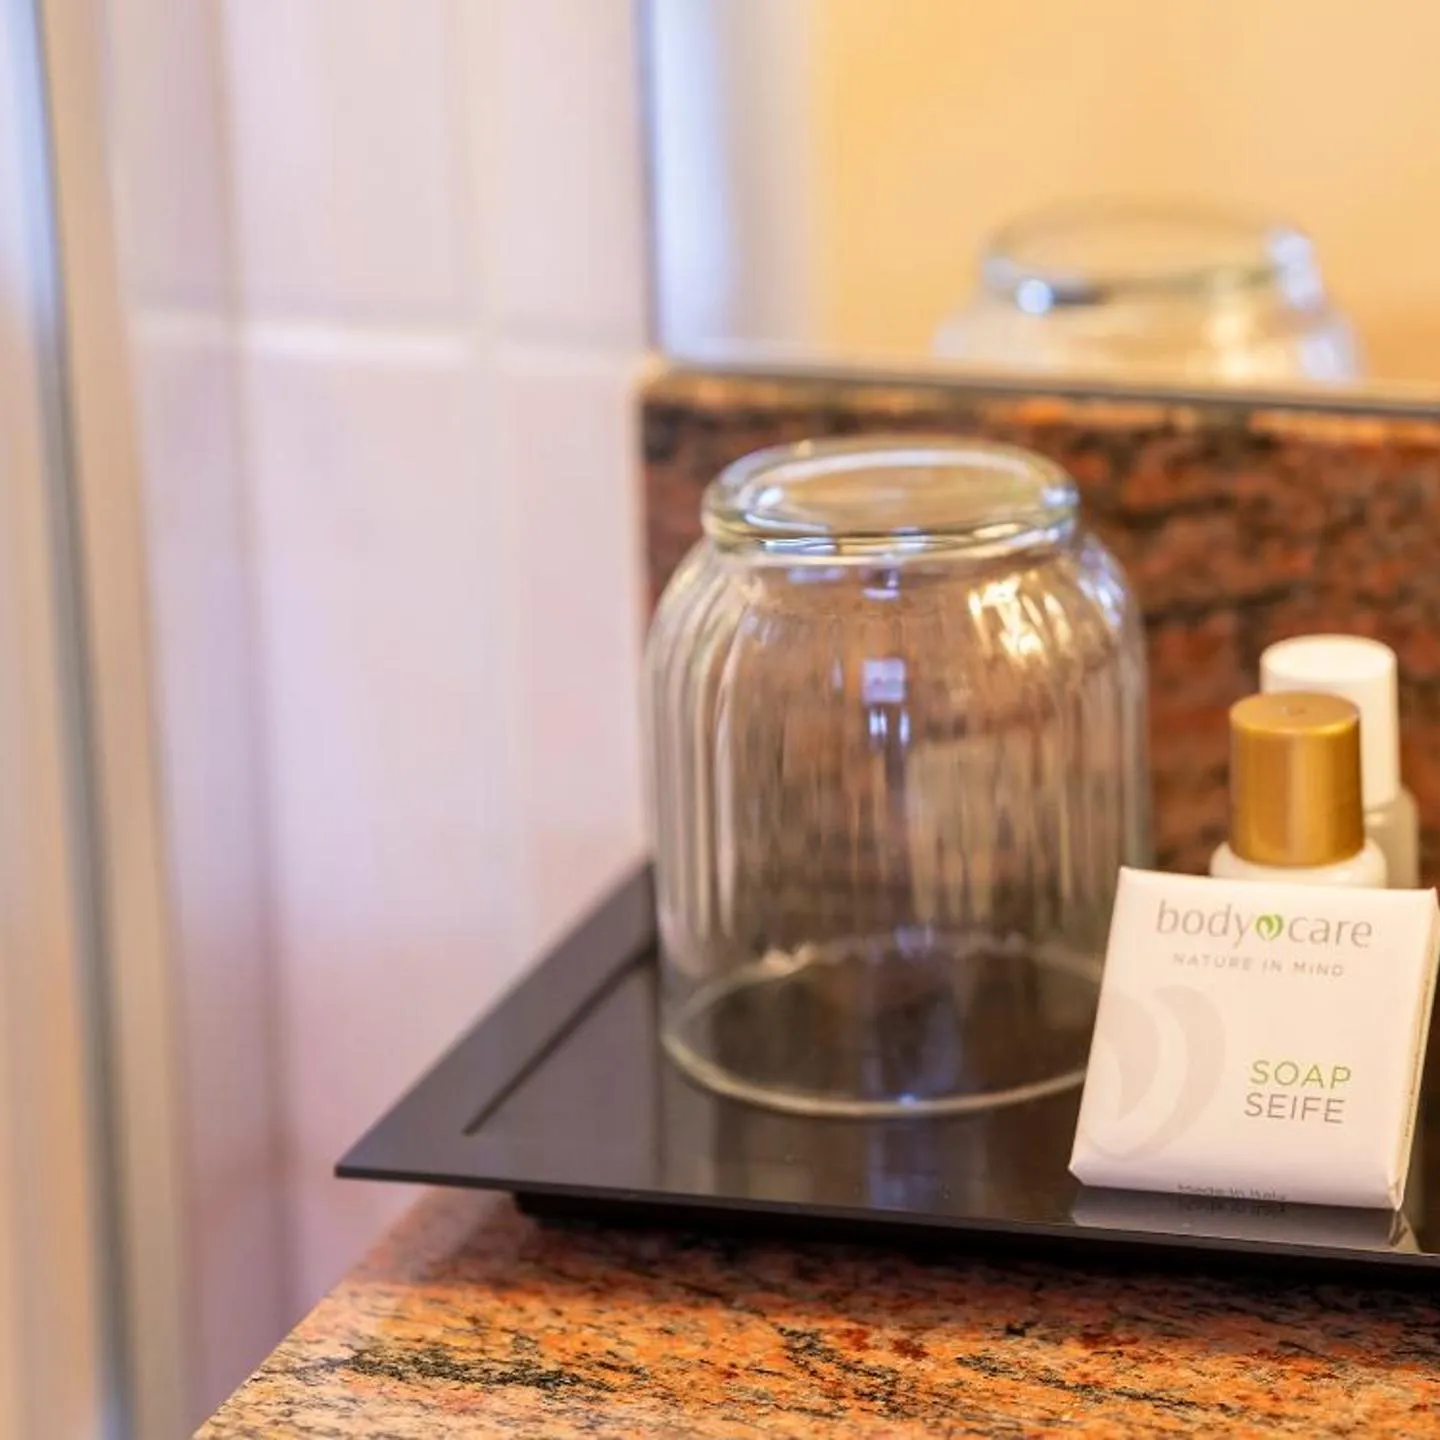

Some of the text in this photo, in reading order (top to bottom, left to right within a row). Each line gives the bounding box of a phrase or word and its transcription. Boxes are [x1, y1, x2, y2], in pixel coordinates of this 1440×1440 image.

[1156, 899, 1373, 949] body care
[1173, 953, 1344, 978] NATURE IN MIND
[1250, 1060, 1352, 1089] SOAP
[1244, 1092, 1345, 1123] SEIFE
